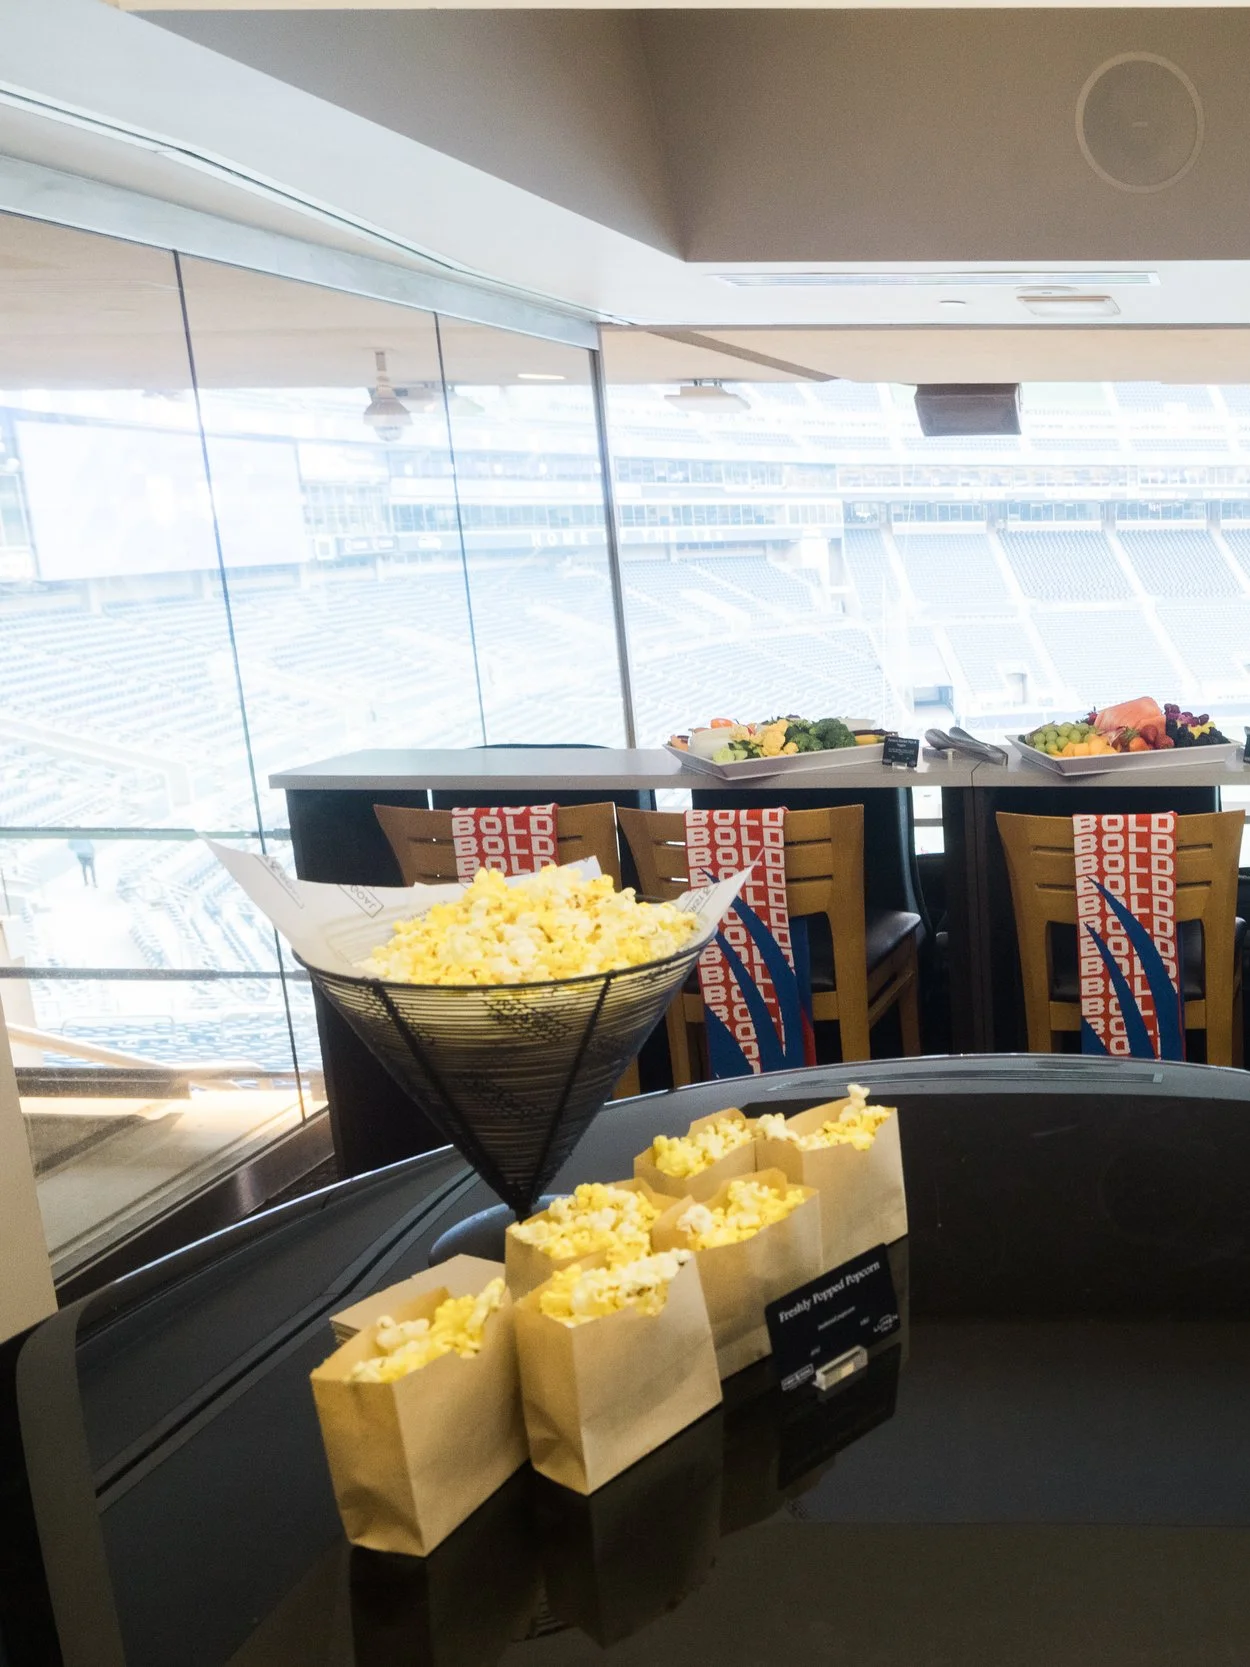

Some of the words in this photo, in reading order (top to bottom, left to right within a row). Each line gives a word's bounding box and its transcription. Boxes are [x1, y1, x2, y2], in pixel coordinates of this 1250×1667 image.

[452, 816, 553, 836] BOLD
[686, 809, 784, 826] BOLD
[1073, 814, 1175, 834] BOLD
[454, 836, 554, 856] BOLD
[687, 826, 784, 846] BOLD
[1074, 833, 1174, 855] BOLD
[688, 846, 785, 867] BOLD
[1075, 853, 1174, 876] BOLD
[1076, 874, 1174, 896] BOLD
[778, 1298, 812, 1323] Freshly
[812, 1278, 845, 1305] Popped
[845, 1261, 881, 1286] Popcorn
